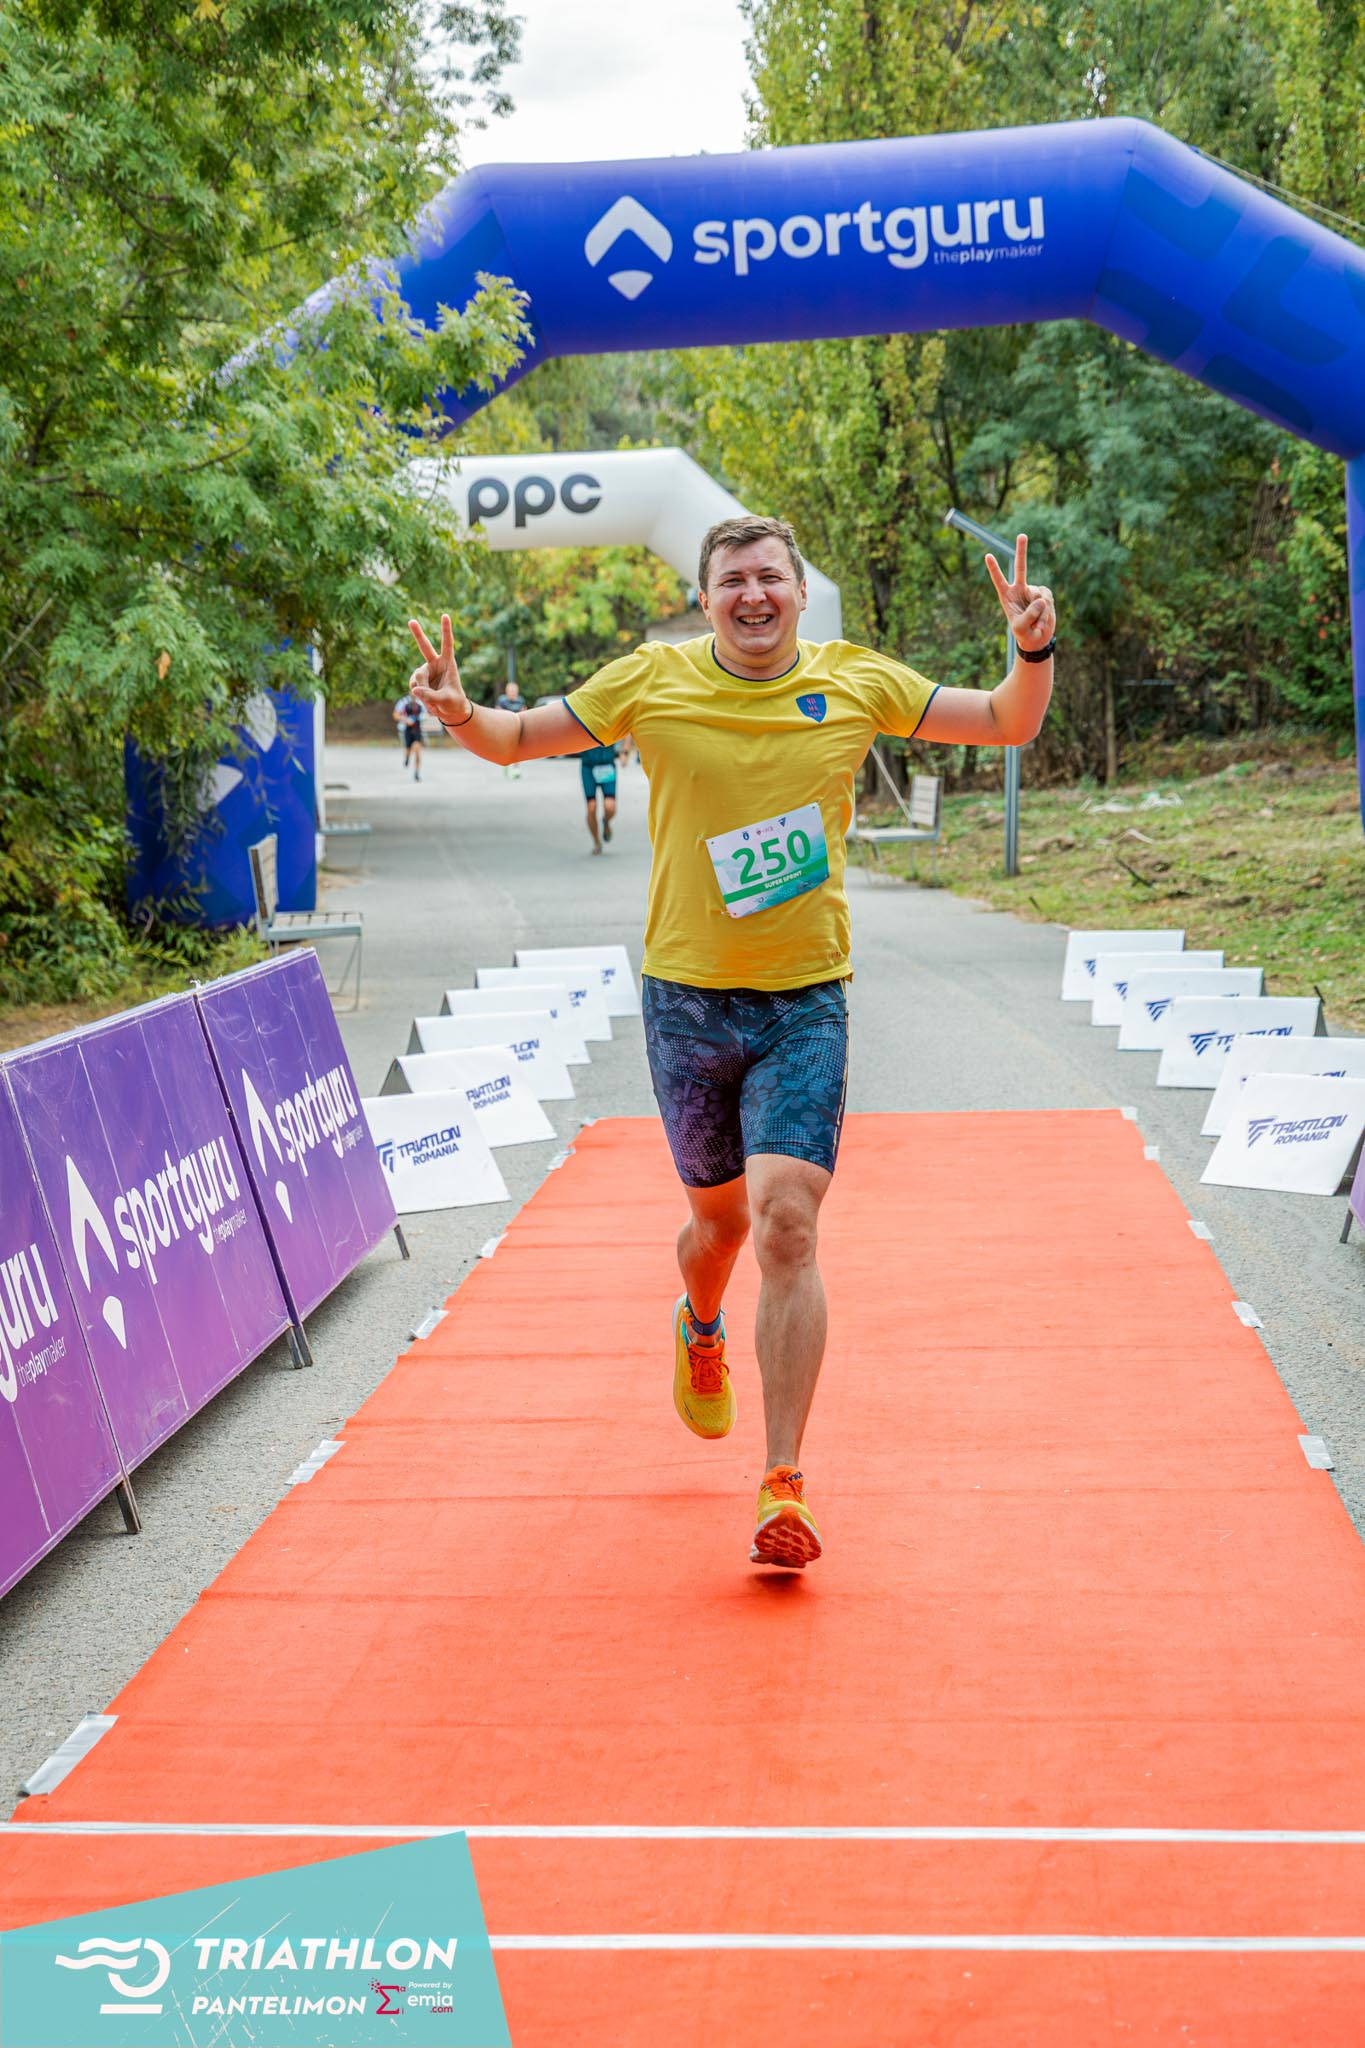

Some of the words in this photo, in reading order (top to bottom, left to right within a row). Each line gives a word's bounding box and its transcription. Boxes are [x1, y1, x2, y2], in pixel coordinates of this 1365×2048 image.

[693, 196, 1045, 276] sportguru
[933, 244, 1044, 264] theplaymaker
[468, 473, 602, 528] ppc
[731, 829, 811, 885] 250
[764, 878, 783, 889] SUPER
[783, 870, 802, 882] SPRINT
[465, 1074, 511, 1101] RIATLON
[275, 1064, 358, 1177] sportguru
[1270, 1114, 1349, 1136] TRIATLON
[396, 1125, 461, 1158] TRIATLON
[1273, 1130, 1331, 1145] ROMANIA
[412, 1143, 459, 1166] ROMANIA
[113, 1135, 240, 1285] sportguru
[16, 1336, 67, 1387] theplaymaker
